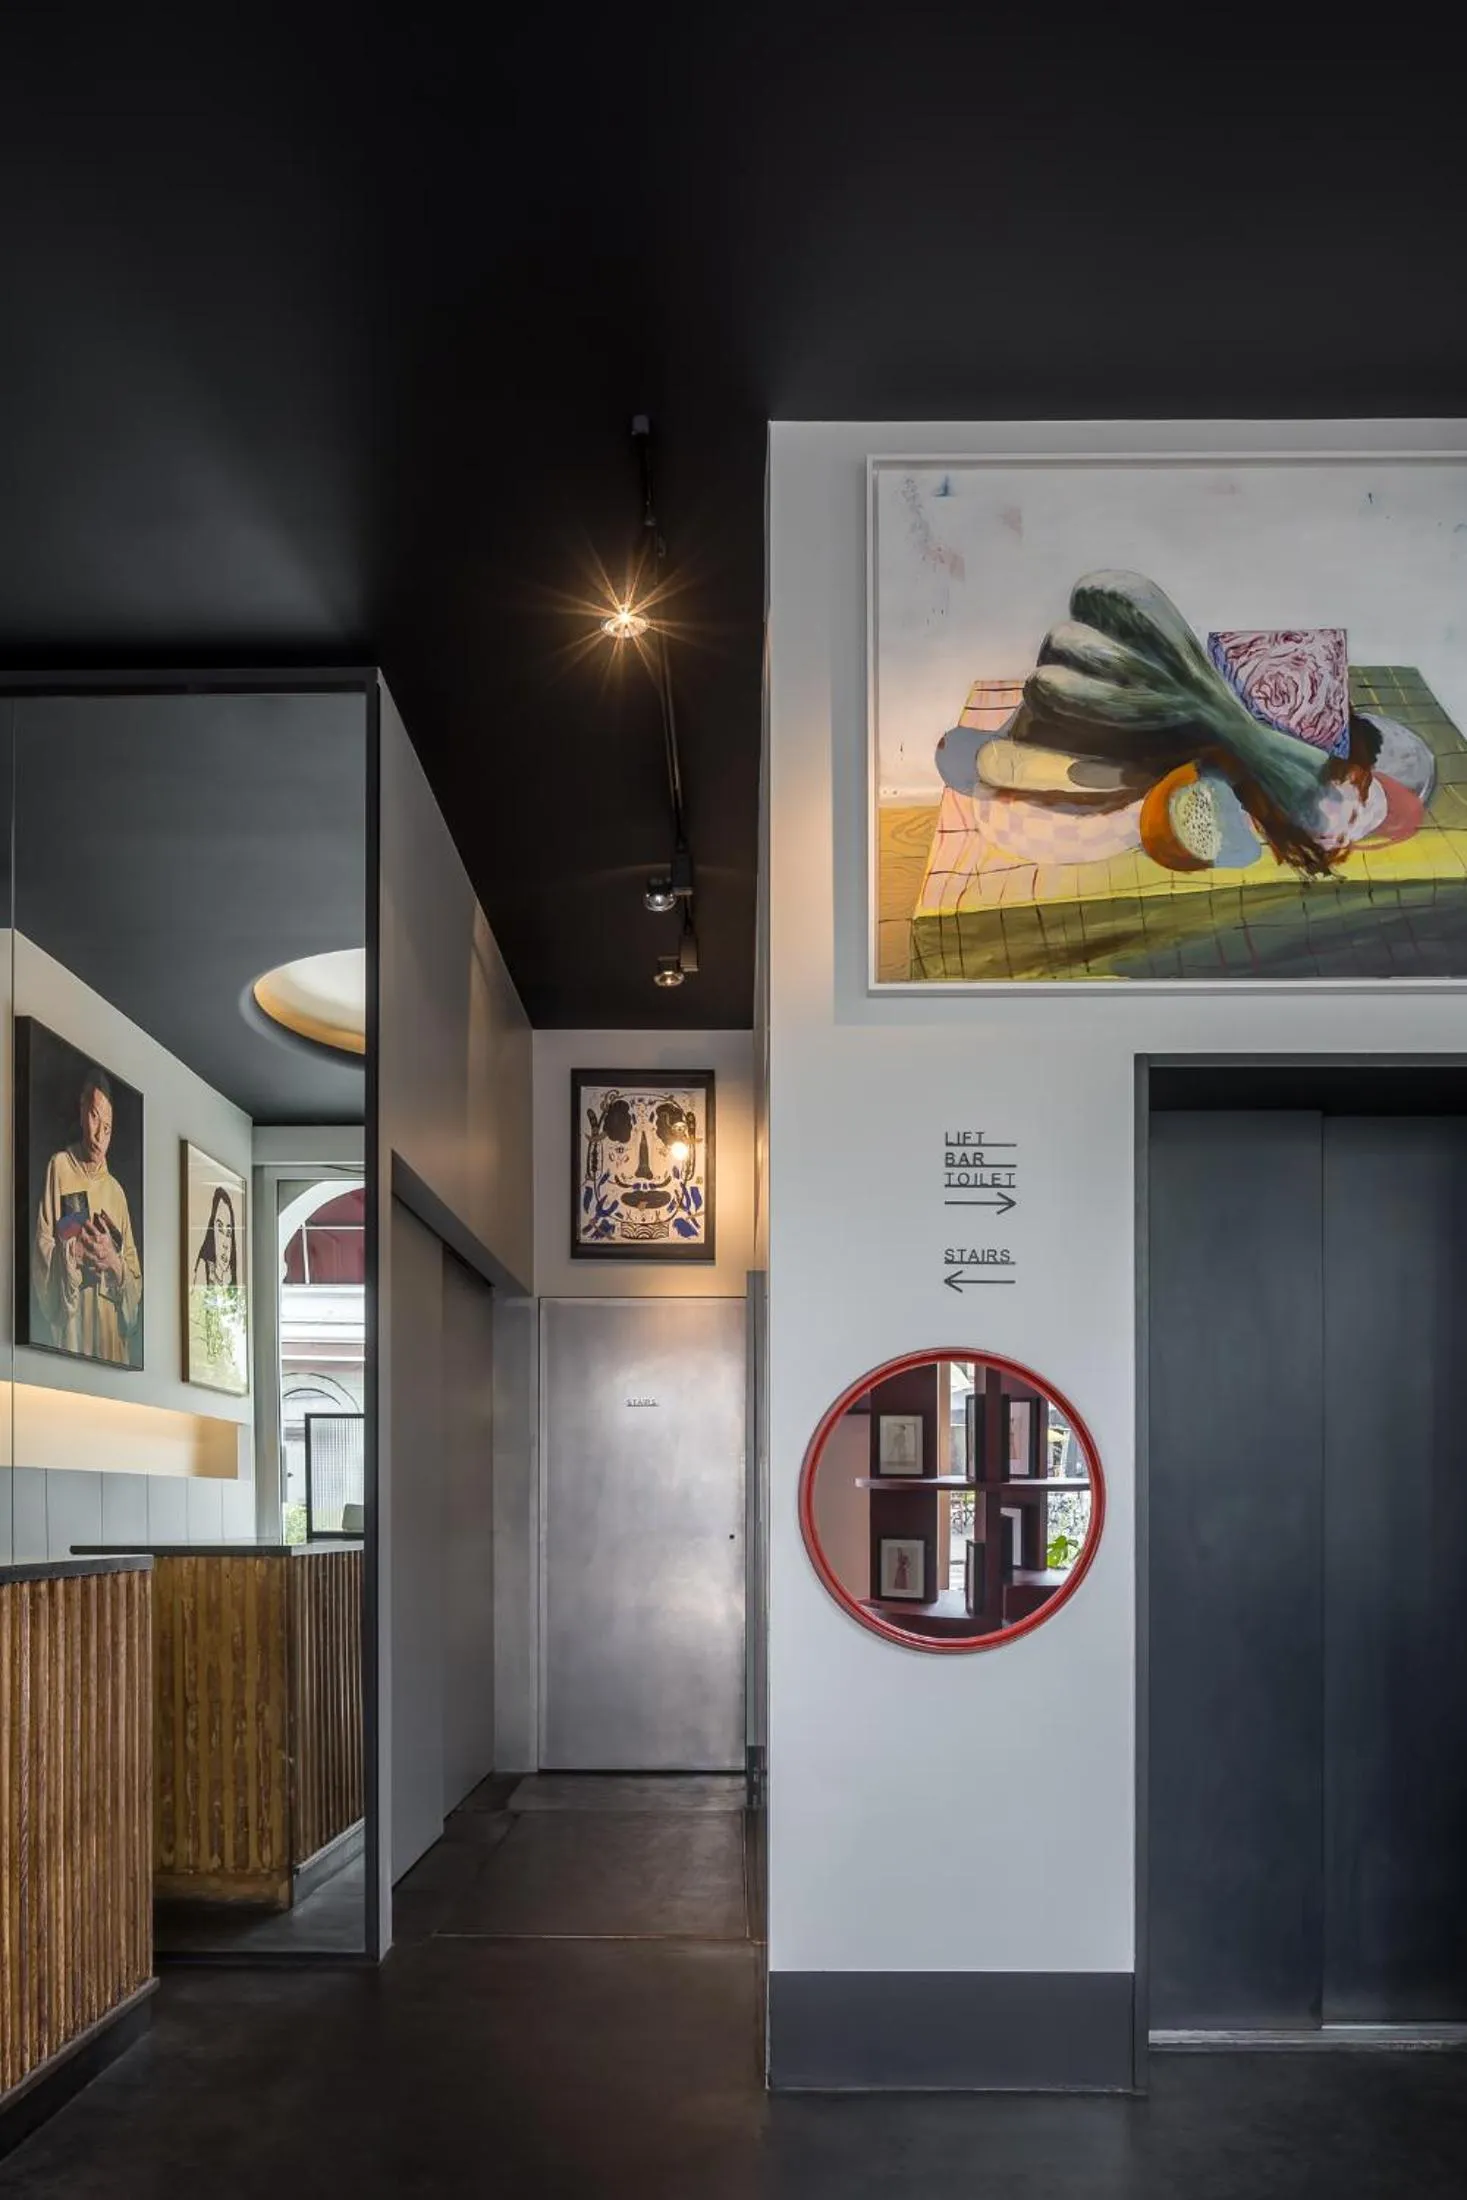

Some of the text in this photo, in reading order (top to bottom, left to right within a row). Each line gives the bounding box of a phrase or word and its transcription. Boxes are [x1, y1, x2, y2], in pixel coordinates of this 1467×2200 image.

[945, 1131, 985, 1145] LIFT
[945, 1152, 985, 1166] BAR
[944, 1172, 1016, 1186] TOILET
[944, 1248, 1011, 1263] STAIRS
